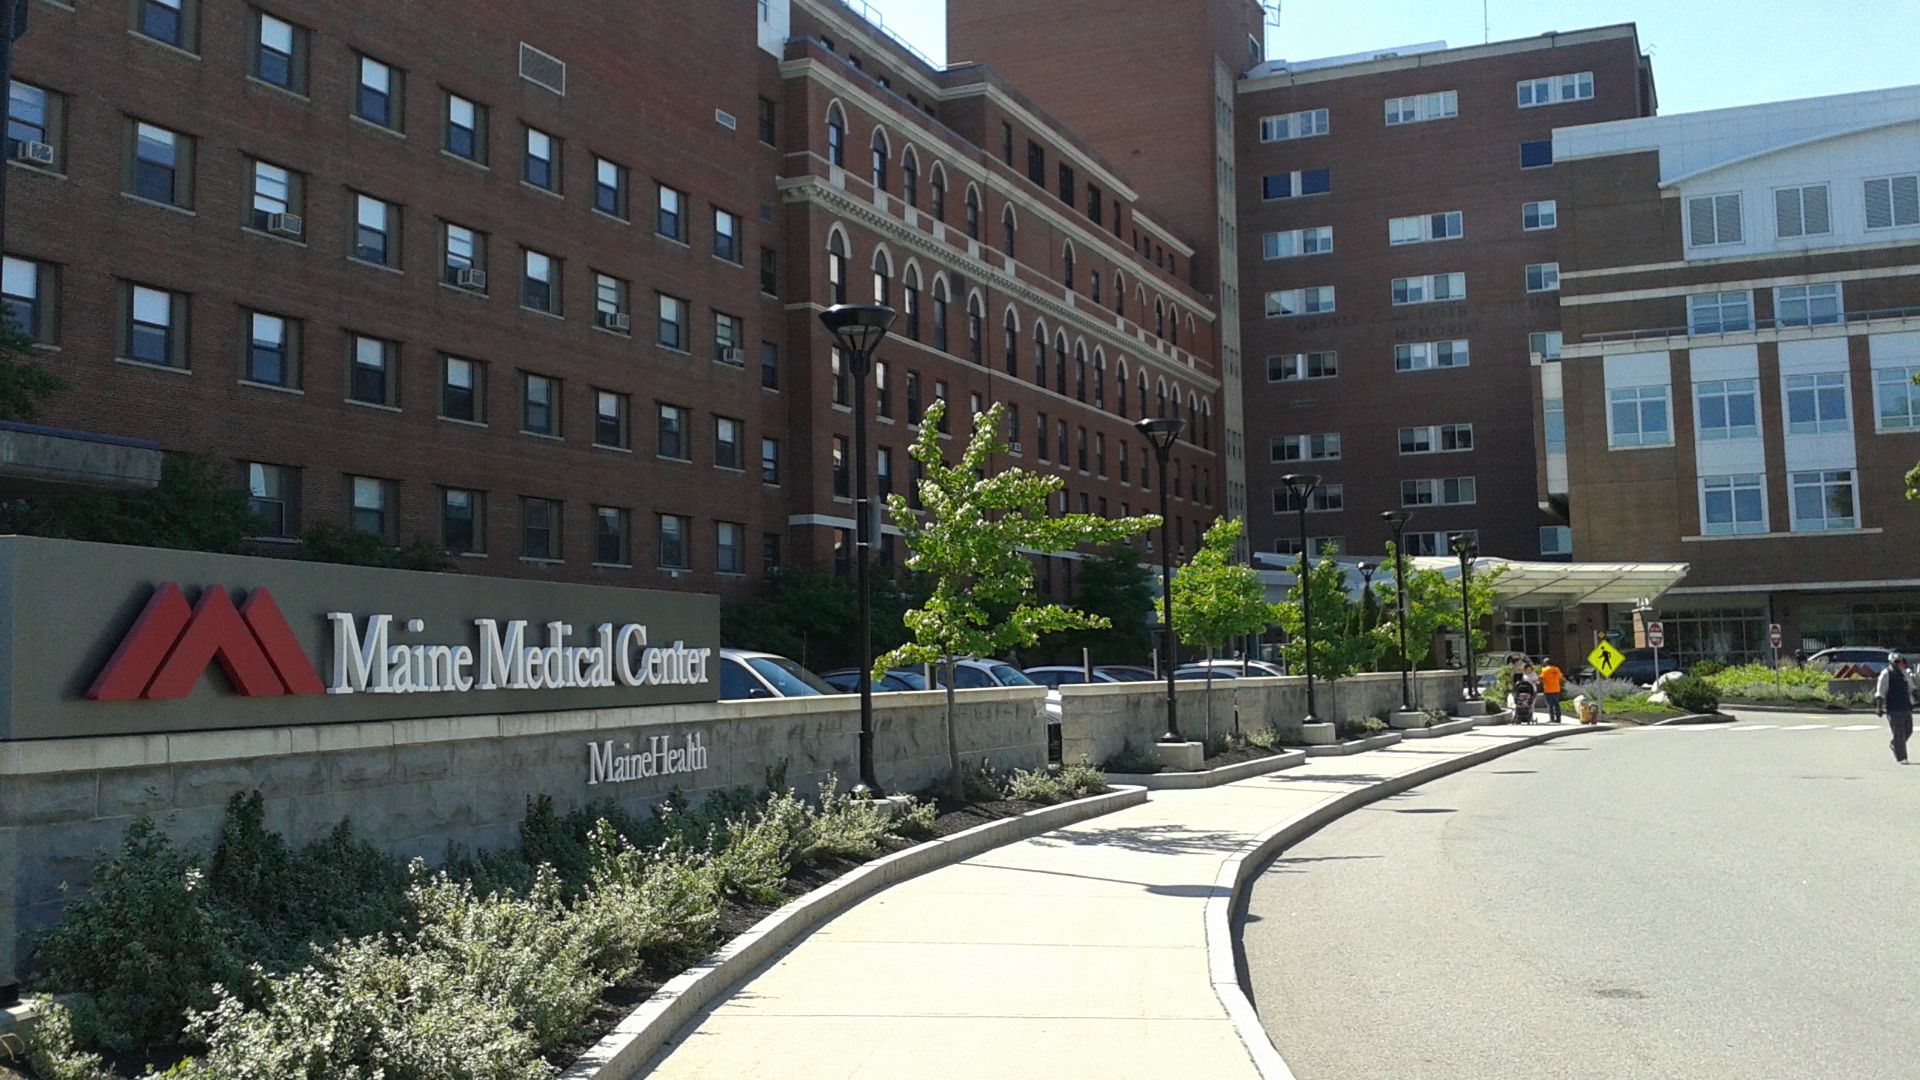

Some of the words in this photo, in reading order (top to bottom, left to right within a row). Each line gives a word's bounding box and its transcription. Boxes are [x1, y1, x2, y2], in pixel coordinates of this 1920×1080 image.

[327, 612, 473, 693] Maine
[474, 618, 615, 690] Medical
[616, 623, 711, 687] Center
[587, 732, 708, 785] MaineHealth
